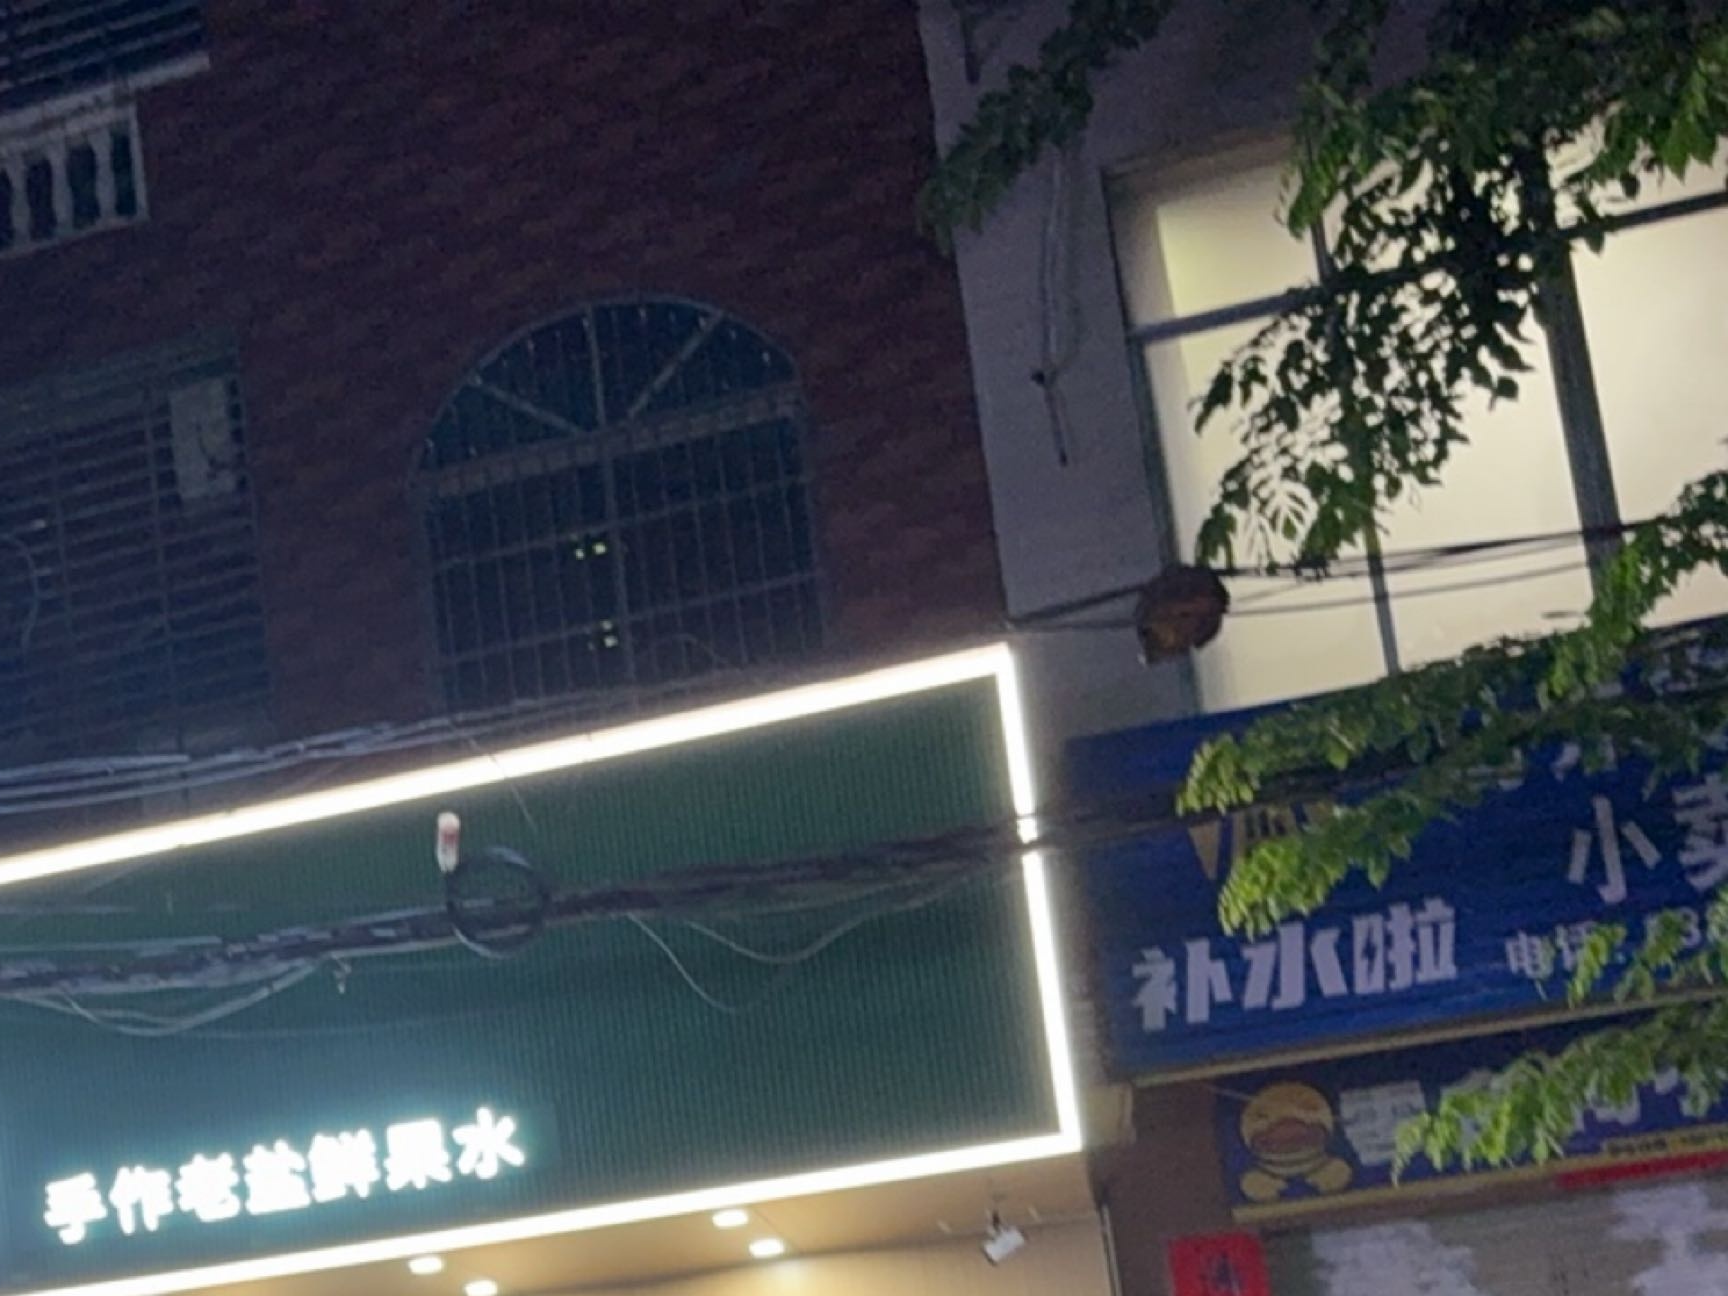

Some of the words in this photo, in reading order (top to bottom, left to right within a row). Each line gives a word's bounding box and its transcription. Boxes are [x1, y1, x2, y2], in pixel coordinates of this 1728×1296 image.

[1132, 897, 1458, 1032] 补水啦
[44, 1107, 525, 1244] 手作老盐鲜果水
